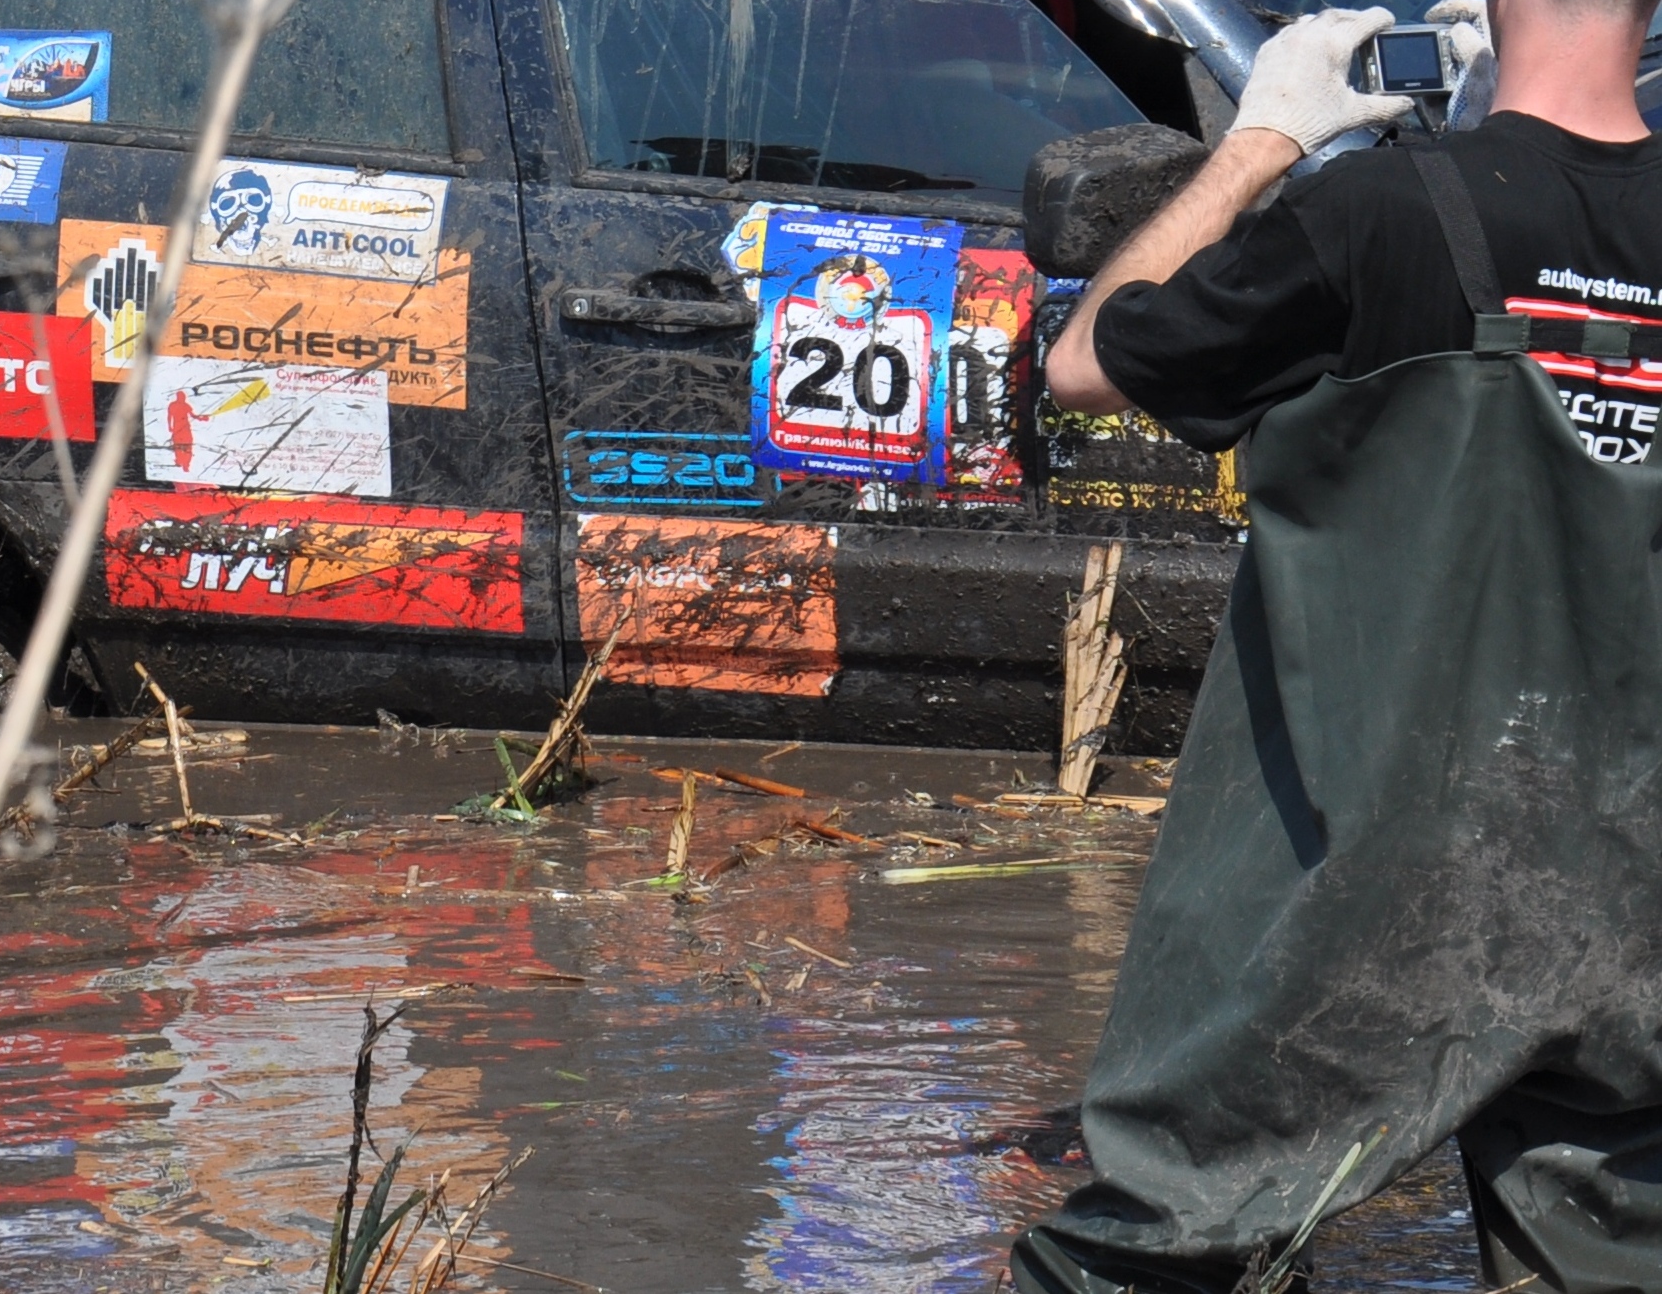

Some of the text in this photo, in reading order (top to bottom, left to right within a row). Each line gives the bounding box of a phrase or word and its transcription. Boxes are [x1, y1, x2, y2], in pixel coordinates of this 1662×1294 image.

[181, 322, 438, 366] РОСНЕФТЬ
[387, 370, 438, 387] ДУКТ»
[785, 336, 910, 418] 20
[180, 551, 288, 594] ЛУЧ
